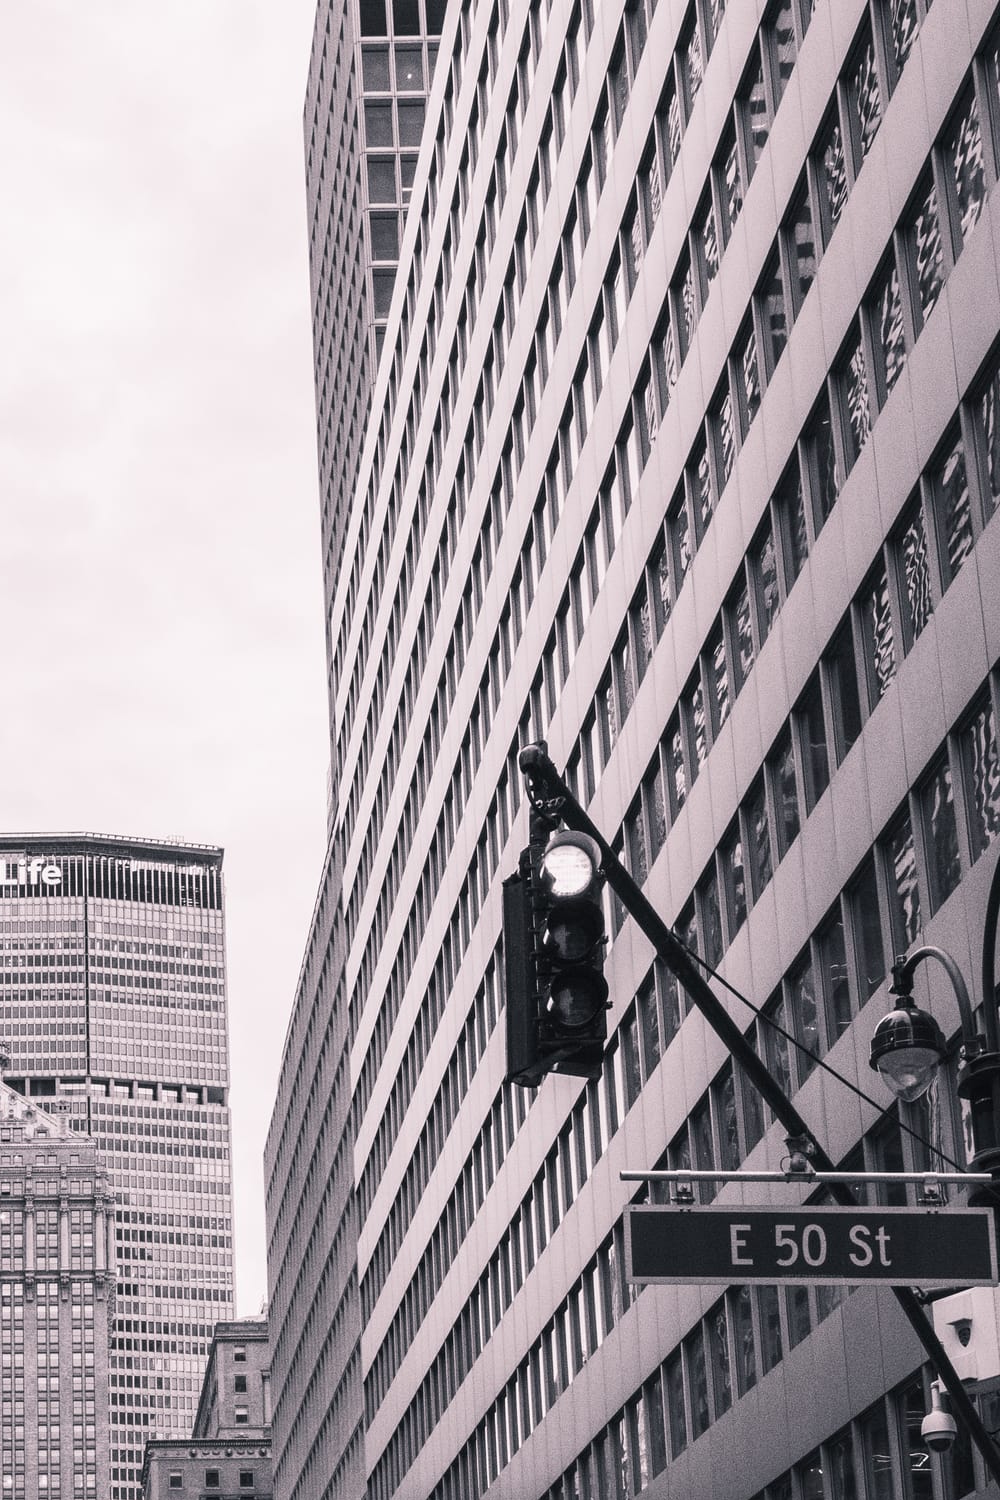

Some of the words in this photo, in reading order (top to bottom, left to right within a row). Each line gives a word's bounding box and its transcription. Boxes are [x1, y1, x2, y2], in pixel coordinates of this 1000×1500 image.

[730, 1224, 754, 1266] E
[775, 1224, 828, 1267] 50
[848, 1224, 892, 1267] St
